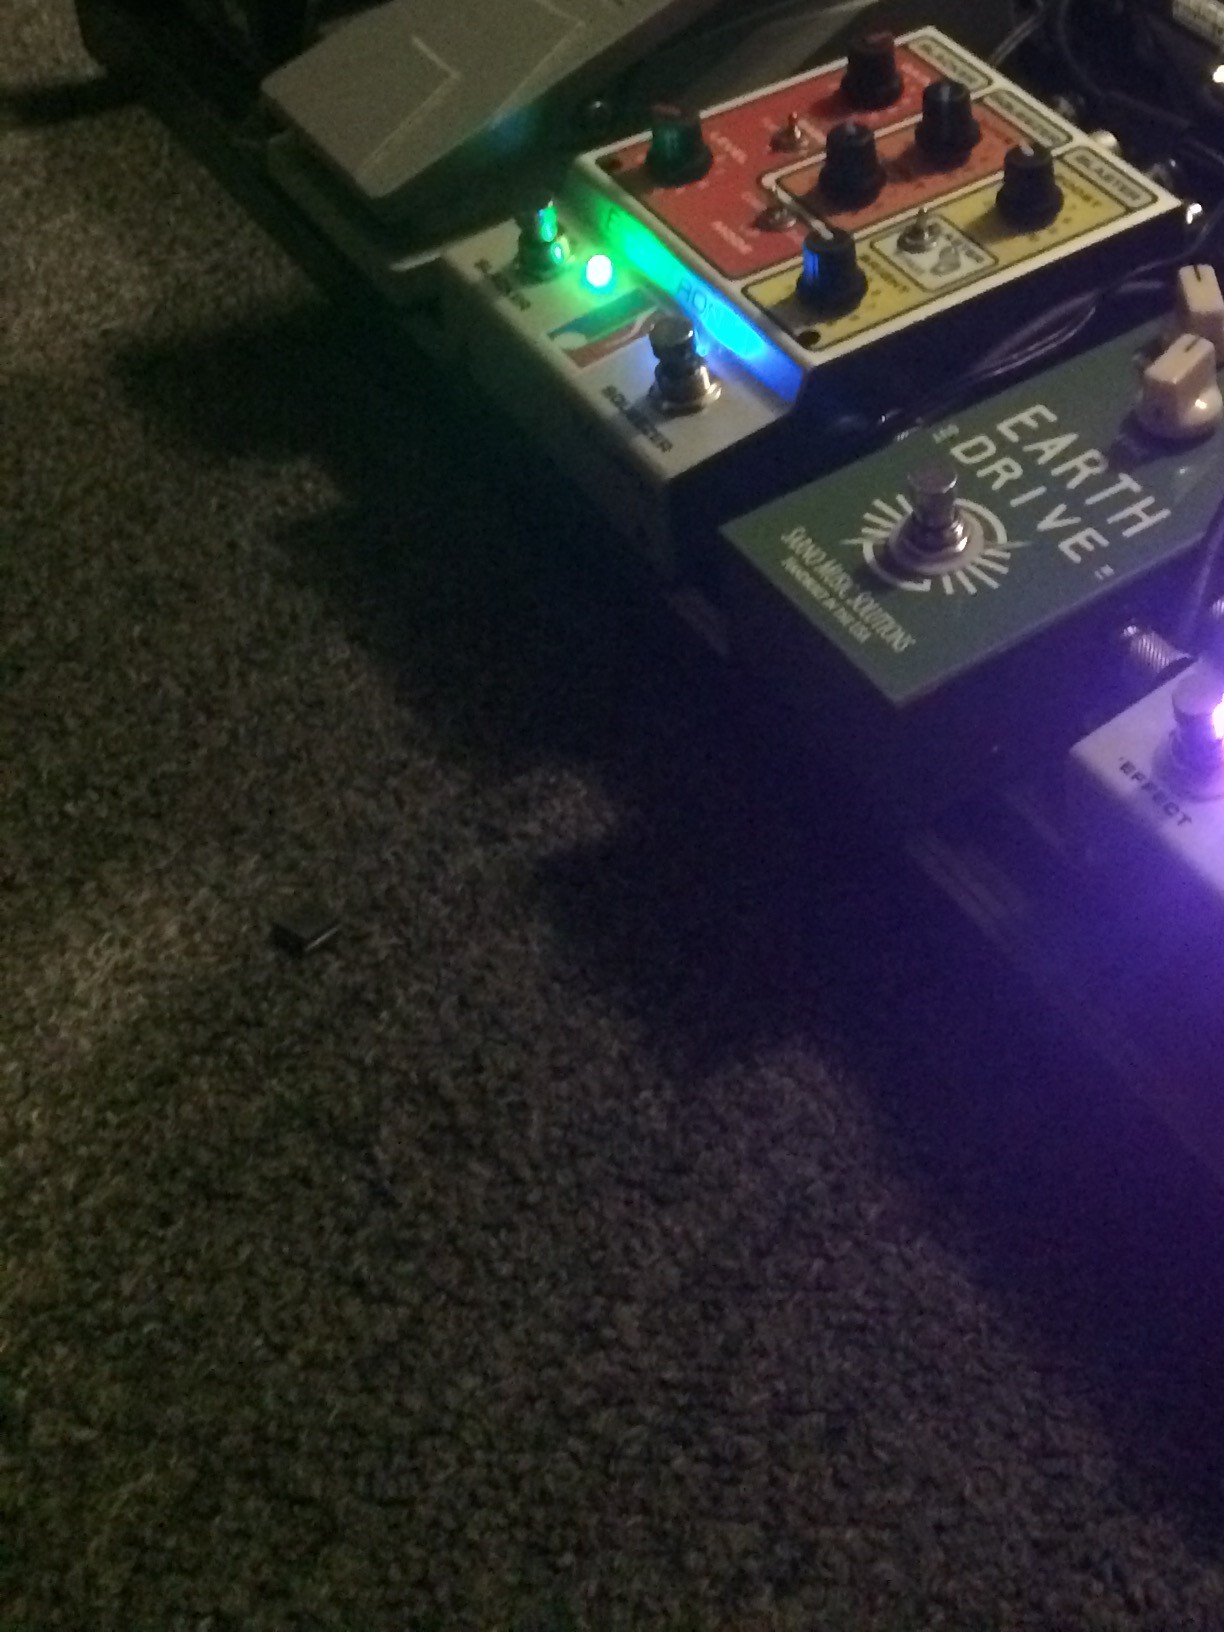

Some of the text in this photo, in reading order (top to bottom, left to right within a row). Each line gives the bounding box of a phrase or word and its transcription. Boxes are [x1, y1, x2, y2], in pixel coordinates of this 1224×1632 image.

[950, 434, 1110, 565] DRIVE
[996, 404, 1172, 538] EARTH
[1119, 759, 1192, 827] EFFECT
